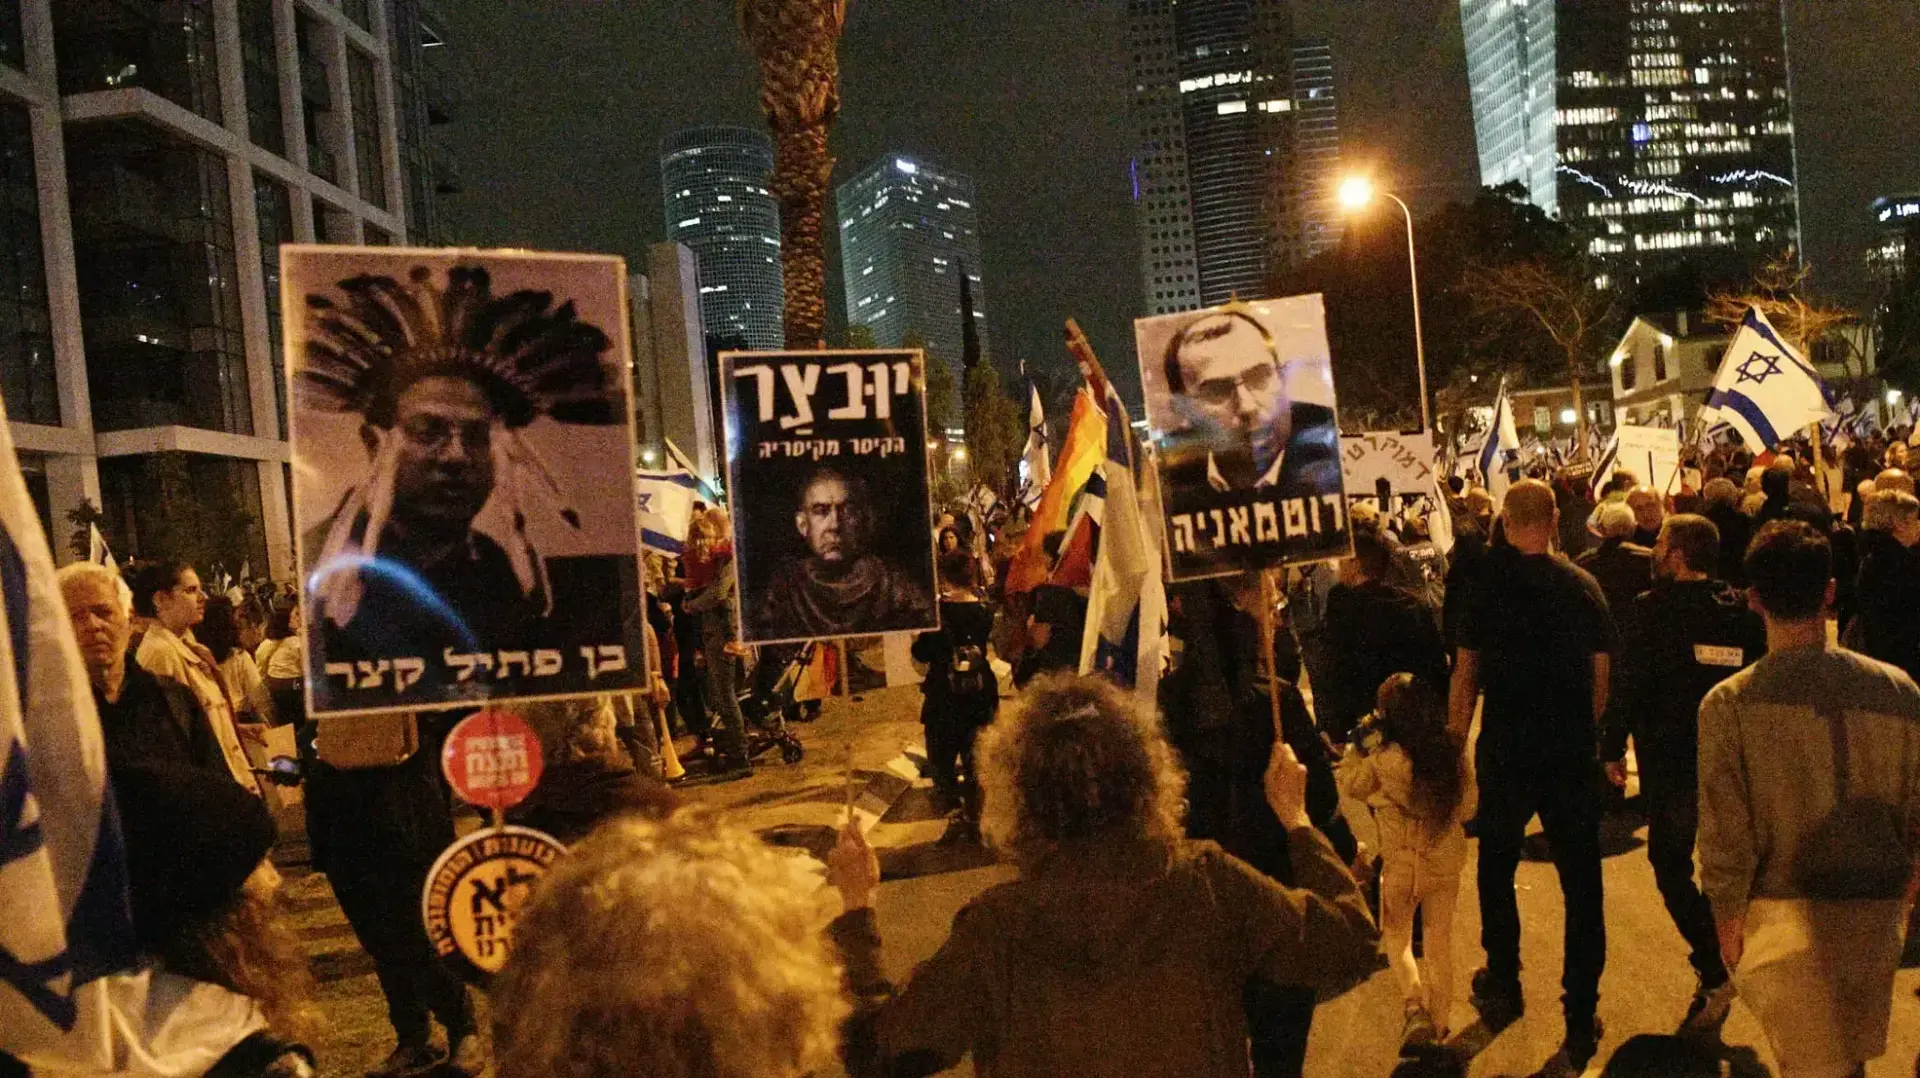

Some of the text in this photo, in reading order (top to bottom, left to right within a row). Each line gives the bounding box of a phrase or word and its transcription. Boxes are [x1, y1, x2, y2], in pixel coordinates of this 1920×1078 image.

[758, 437, 905, 461] הקיסר מקיסריה
[1342, 436, 1431, 480] דמוקרט
[1169, 494, 1344, 553] רוטמאניה
[324, 645, 627, 692] בן פתיל קצר
